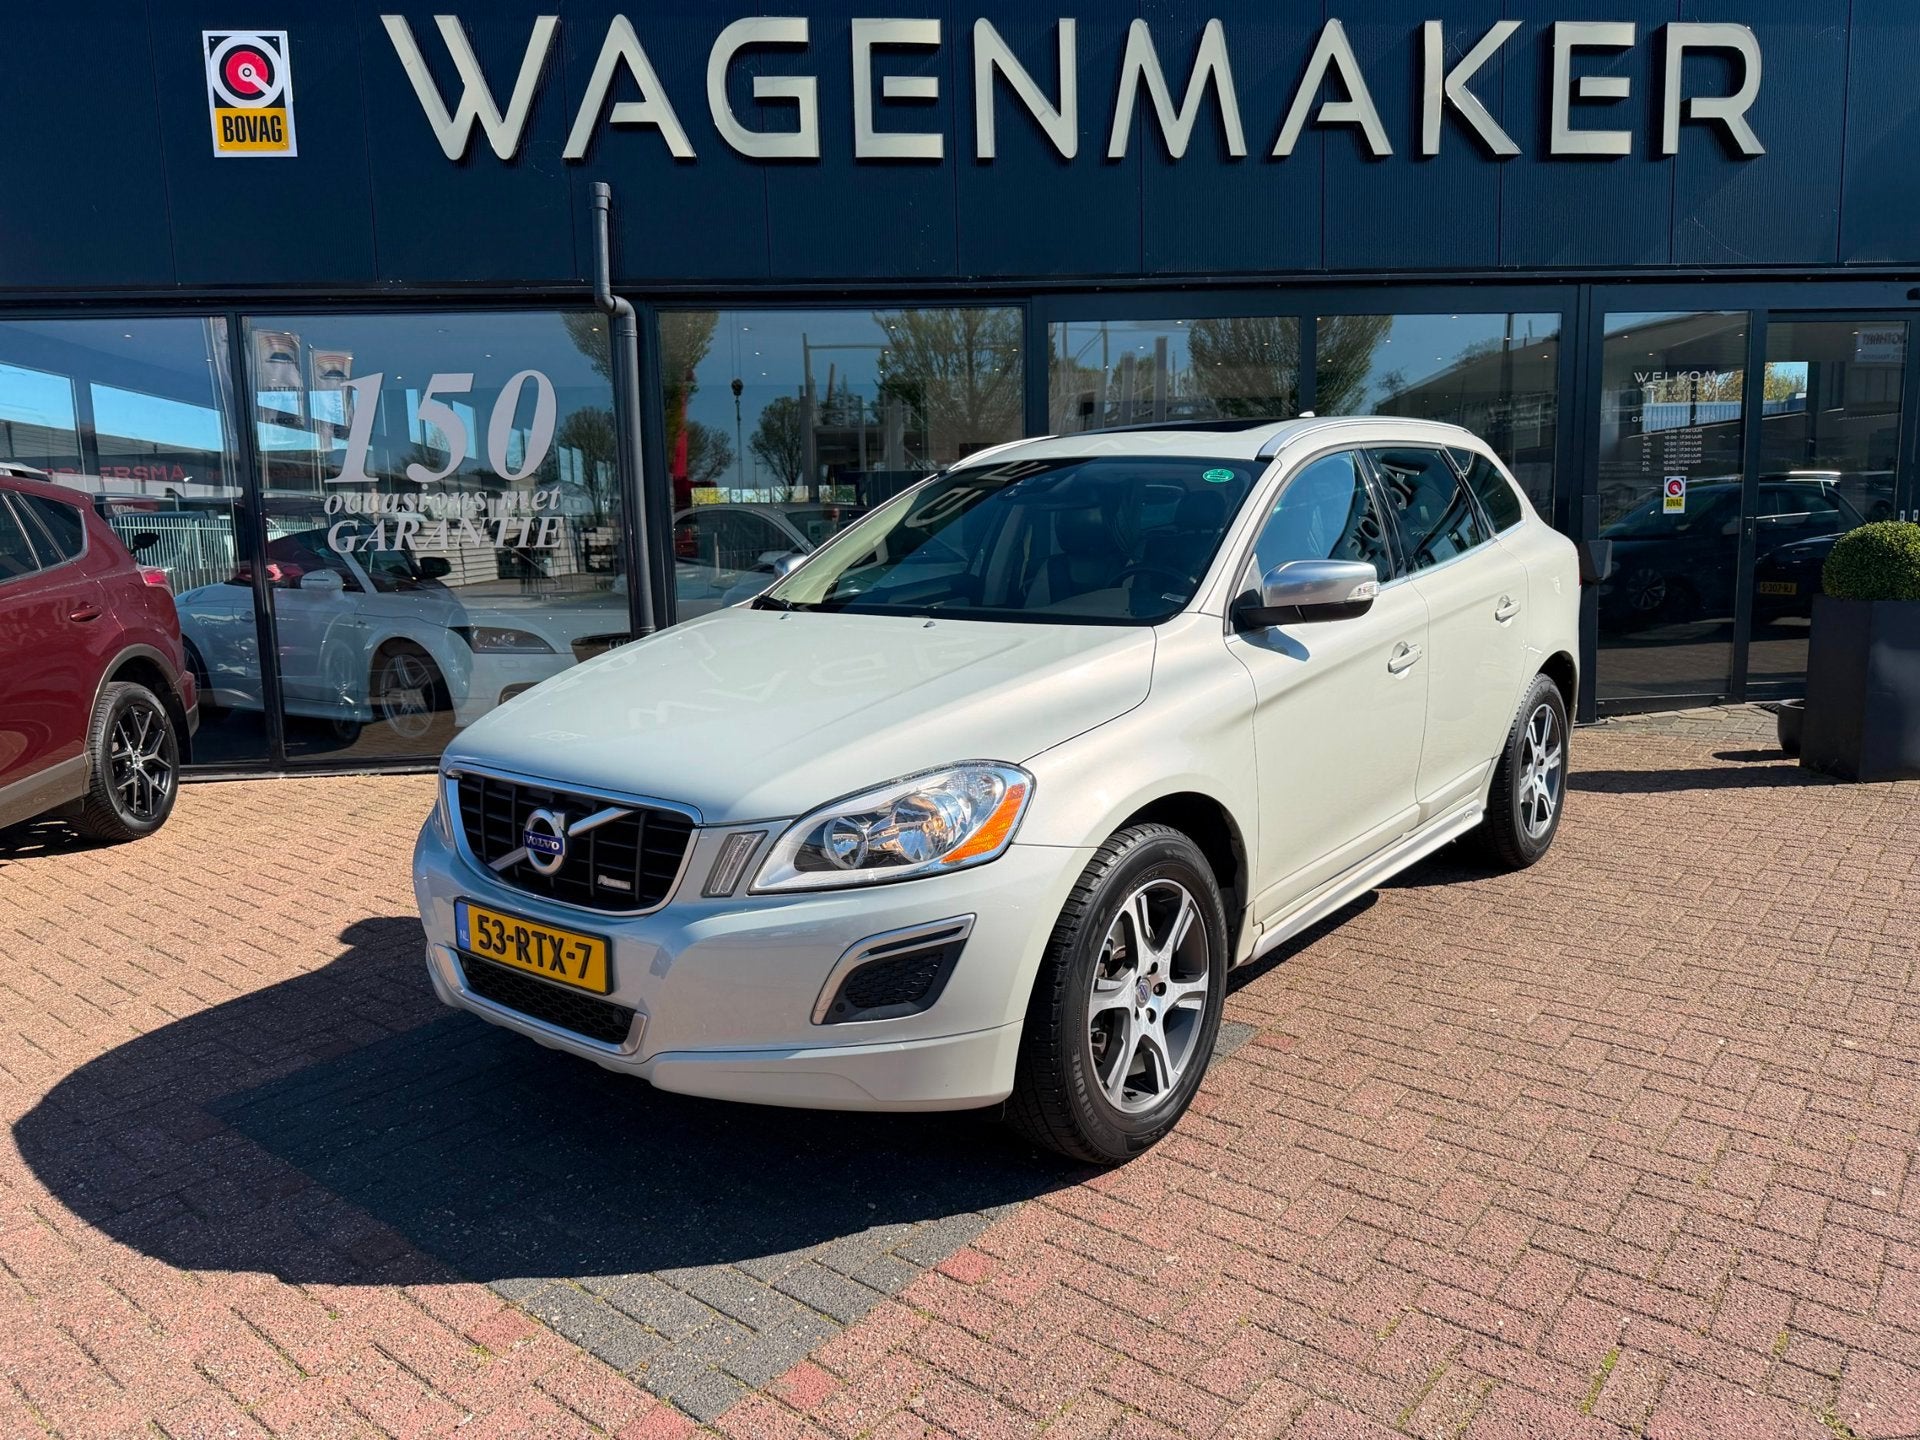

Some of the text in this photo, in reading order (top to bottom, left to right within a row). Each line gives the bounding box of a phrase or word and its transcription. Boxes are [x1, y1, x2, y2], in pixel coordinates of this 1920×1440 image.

[379, 13, 1766, 161] WAGENMAKER
[221, 114, 283, 142] BOVAG
[1633, 370, 1717, 383] WELKOM
[324, 370, 557, 483] 150
[324, 484, 561, 514] occasions met
[327, 516, 564, 553] GARANTIE
[526, 834, 561, 851] VOLVO
[477, 914, 592, 979] 53-RTX-7
